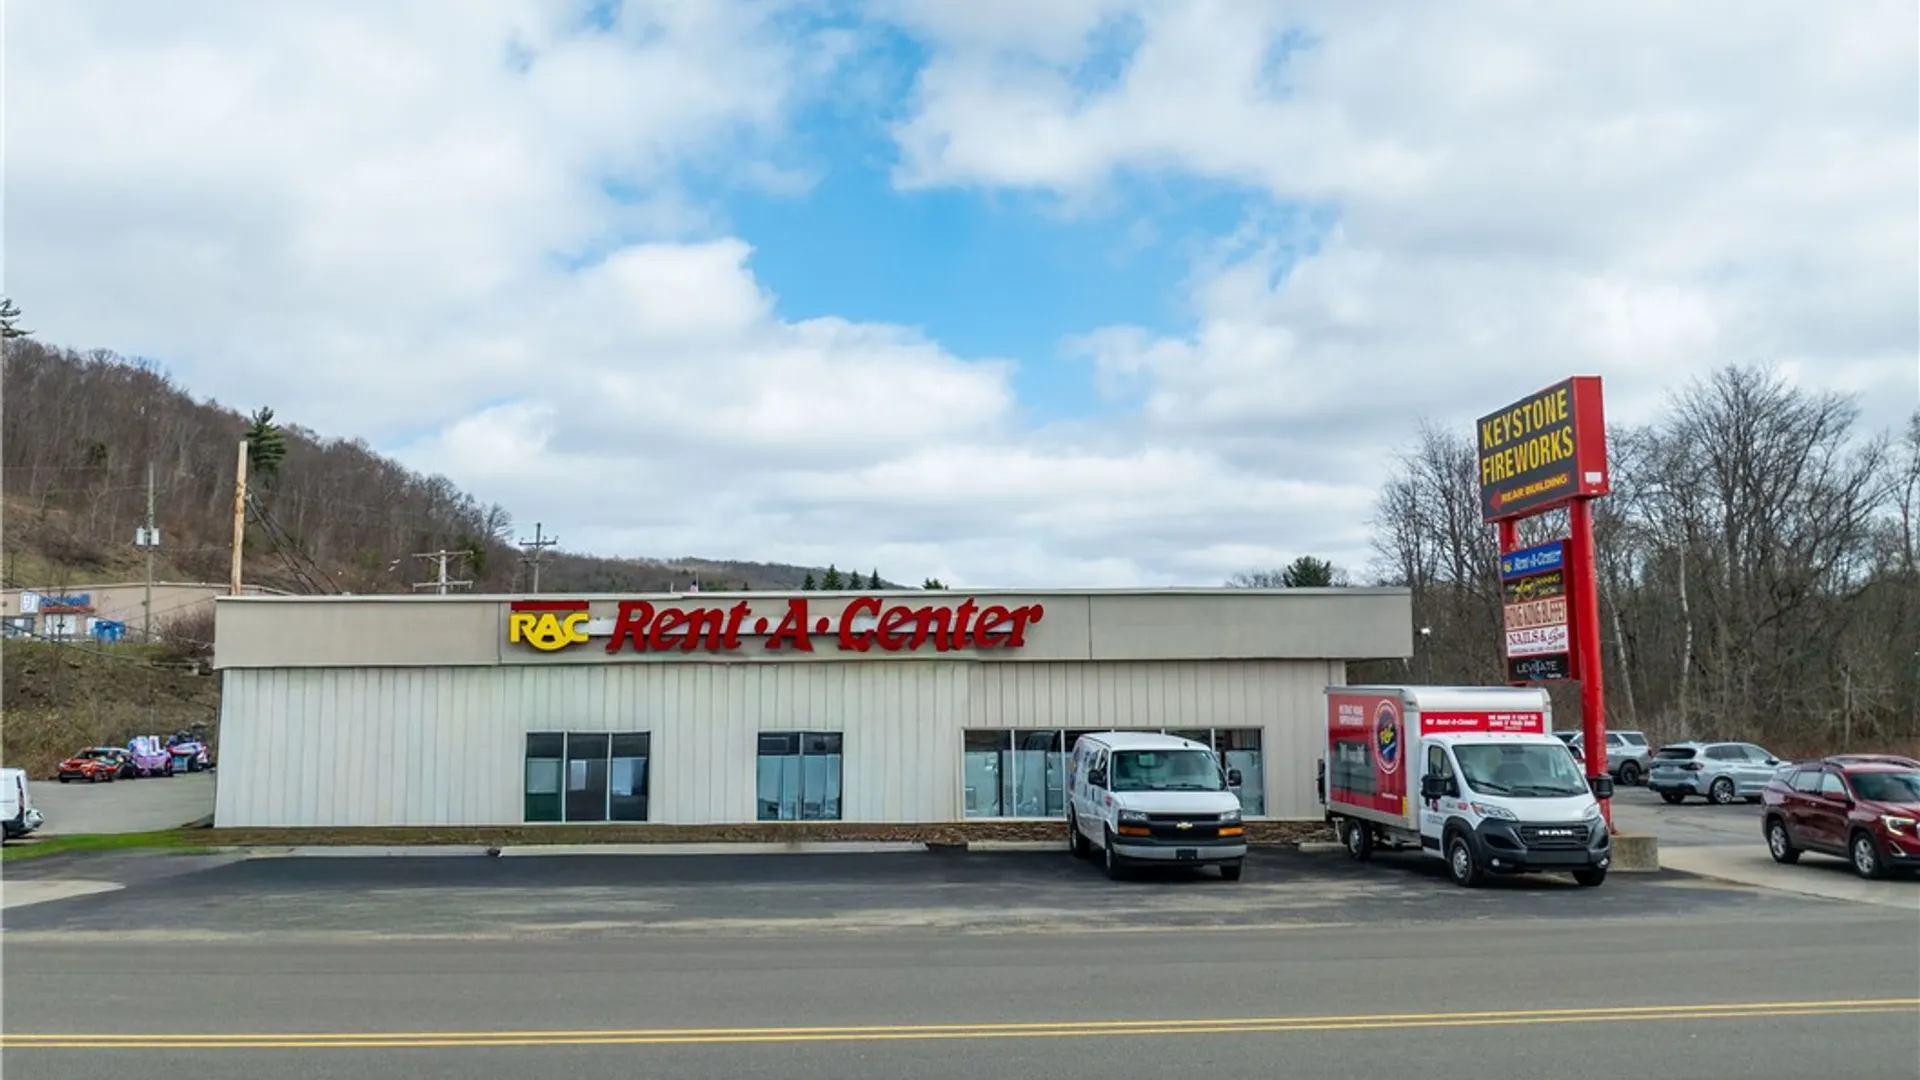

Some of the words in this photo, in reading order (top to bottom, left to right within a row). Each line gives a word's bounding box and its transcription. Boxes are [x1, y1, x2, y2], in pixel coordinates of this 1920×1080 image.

[1482, 388, 1568, 450] KEYSTONE
[1482, 425, 1574, 486] FIREWORKS
[1501, 486, 1525, 503] REAR
[1525, 473, 1568, 494] BUILDING
[510, 612, 589, 651] RAC
